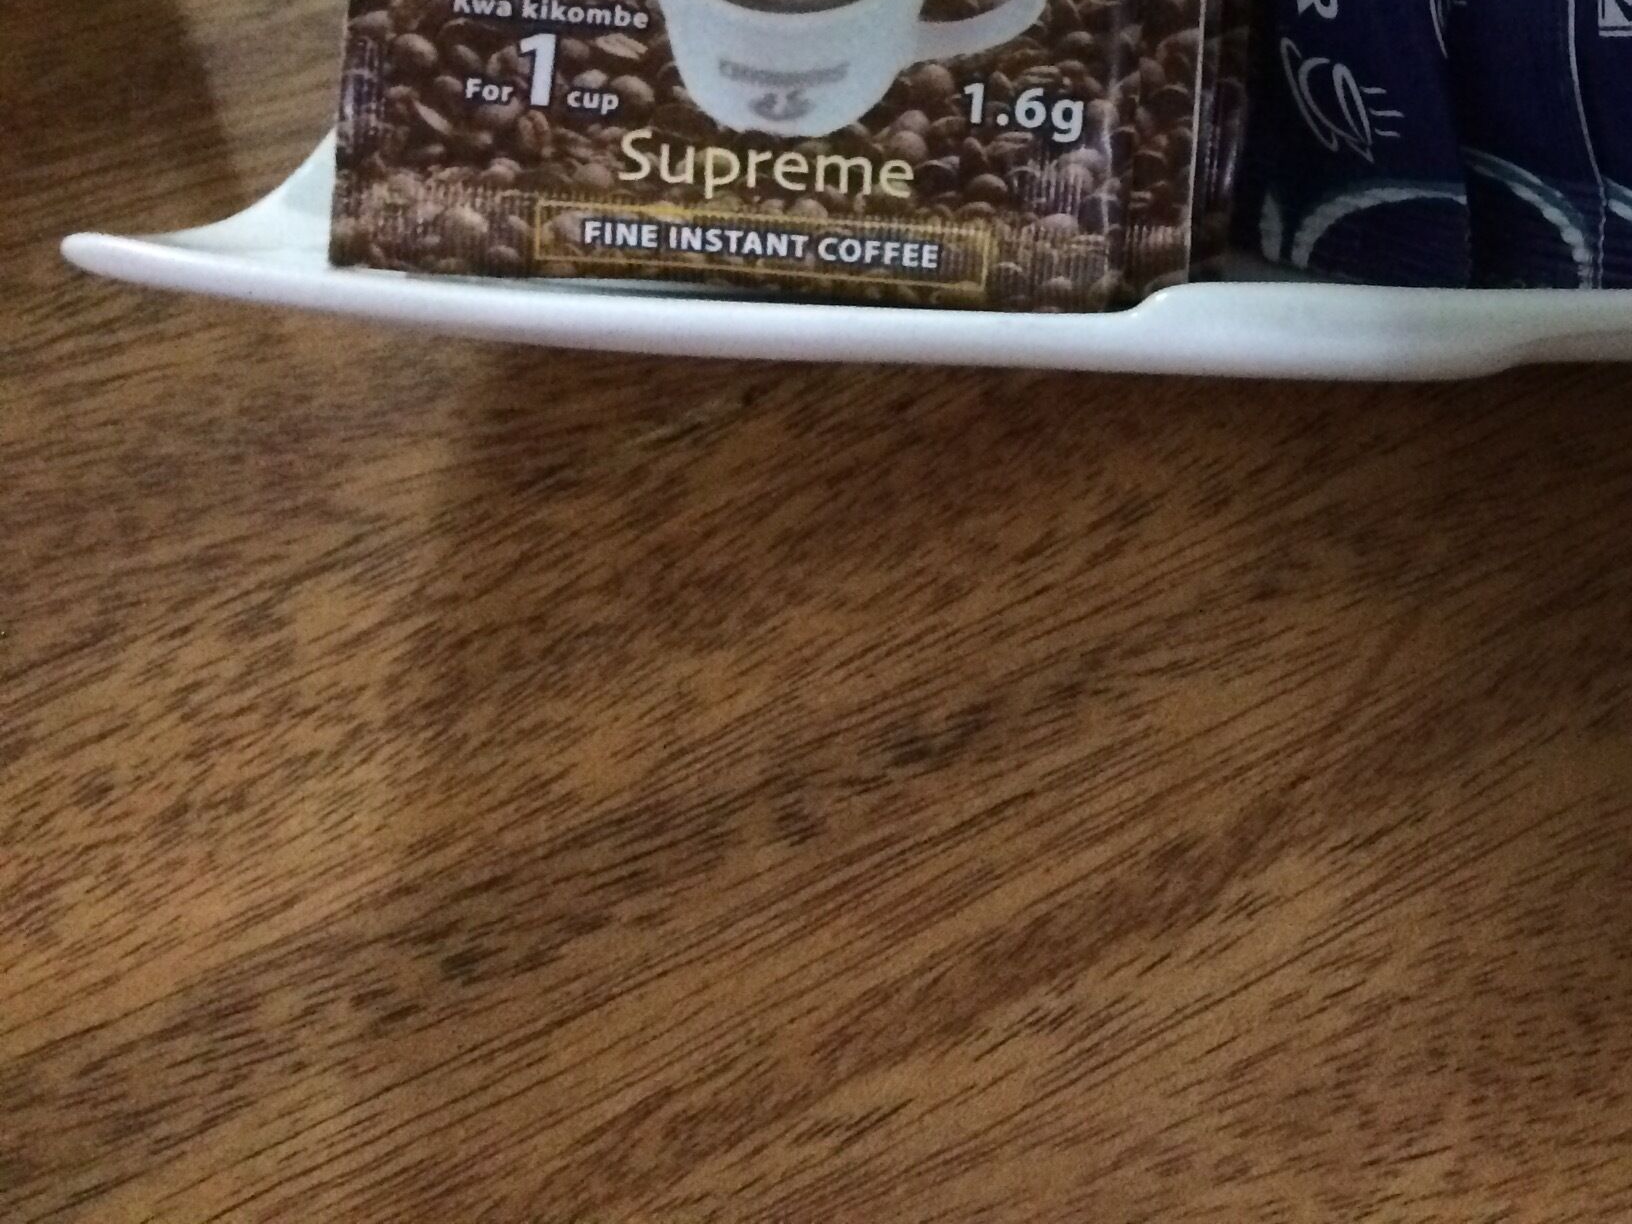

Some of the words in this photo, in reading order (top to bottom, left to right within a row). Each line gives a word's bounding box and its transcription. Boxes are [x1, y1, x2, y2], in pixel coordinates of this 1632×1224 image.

[465, 77, 514, 106] For
[518, 31, 557, 109] 1
[565, 86, 622, 117] cup
[961, 81, 1086, 143] 1.6g
[617, 128, 916, 199] Supreme
[582, 219, 660, 251] FINE
[668, 223, 810, 262] INSTANT
[818, 235, 941, 271] COFFEE
